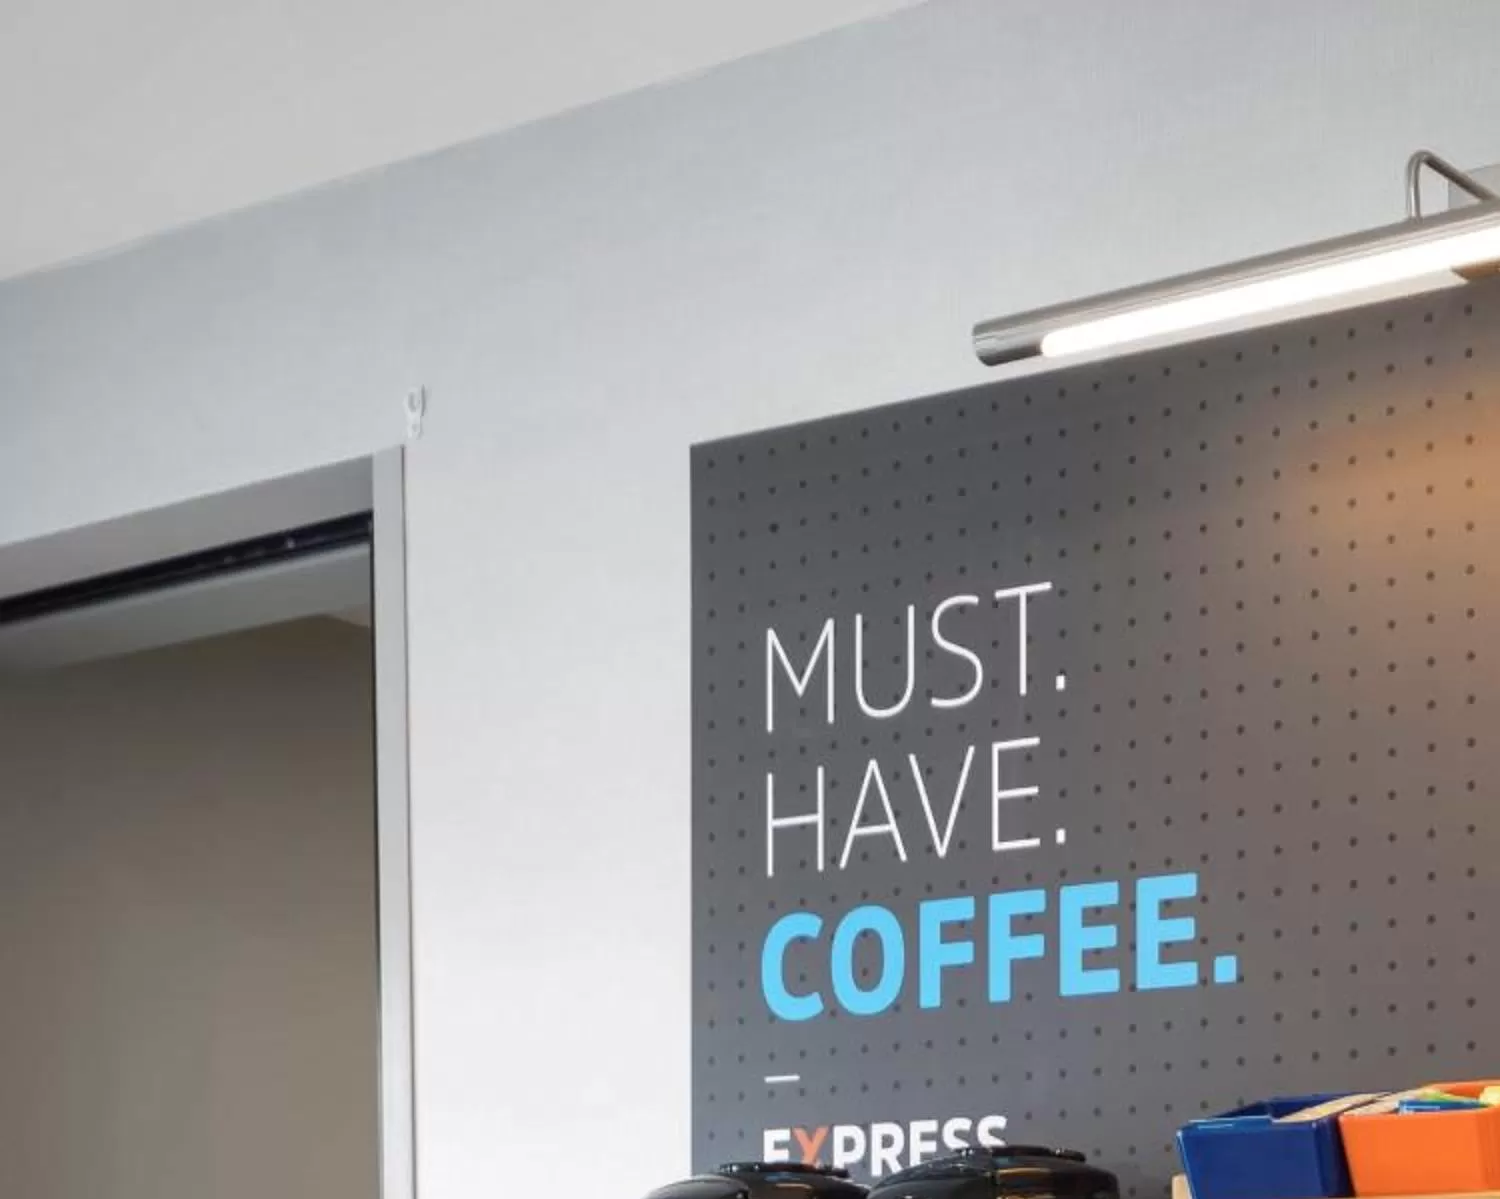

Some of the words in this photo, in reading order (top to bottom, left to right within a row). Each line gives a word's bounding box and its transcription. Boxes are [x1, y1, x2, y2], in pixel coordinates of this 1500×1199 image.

[766, 581, 1066, 733] MUST.
[766, 737, 1066, 878] HAVE.
[760, 871, 1238, 1022] COFFEE.
[762, 1115, 1008, 1177] EXPRESS
